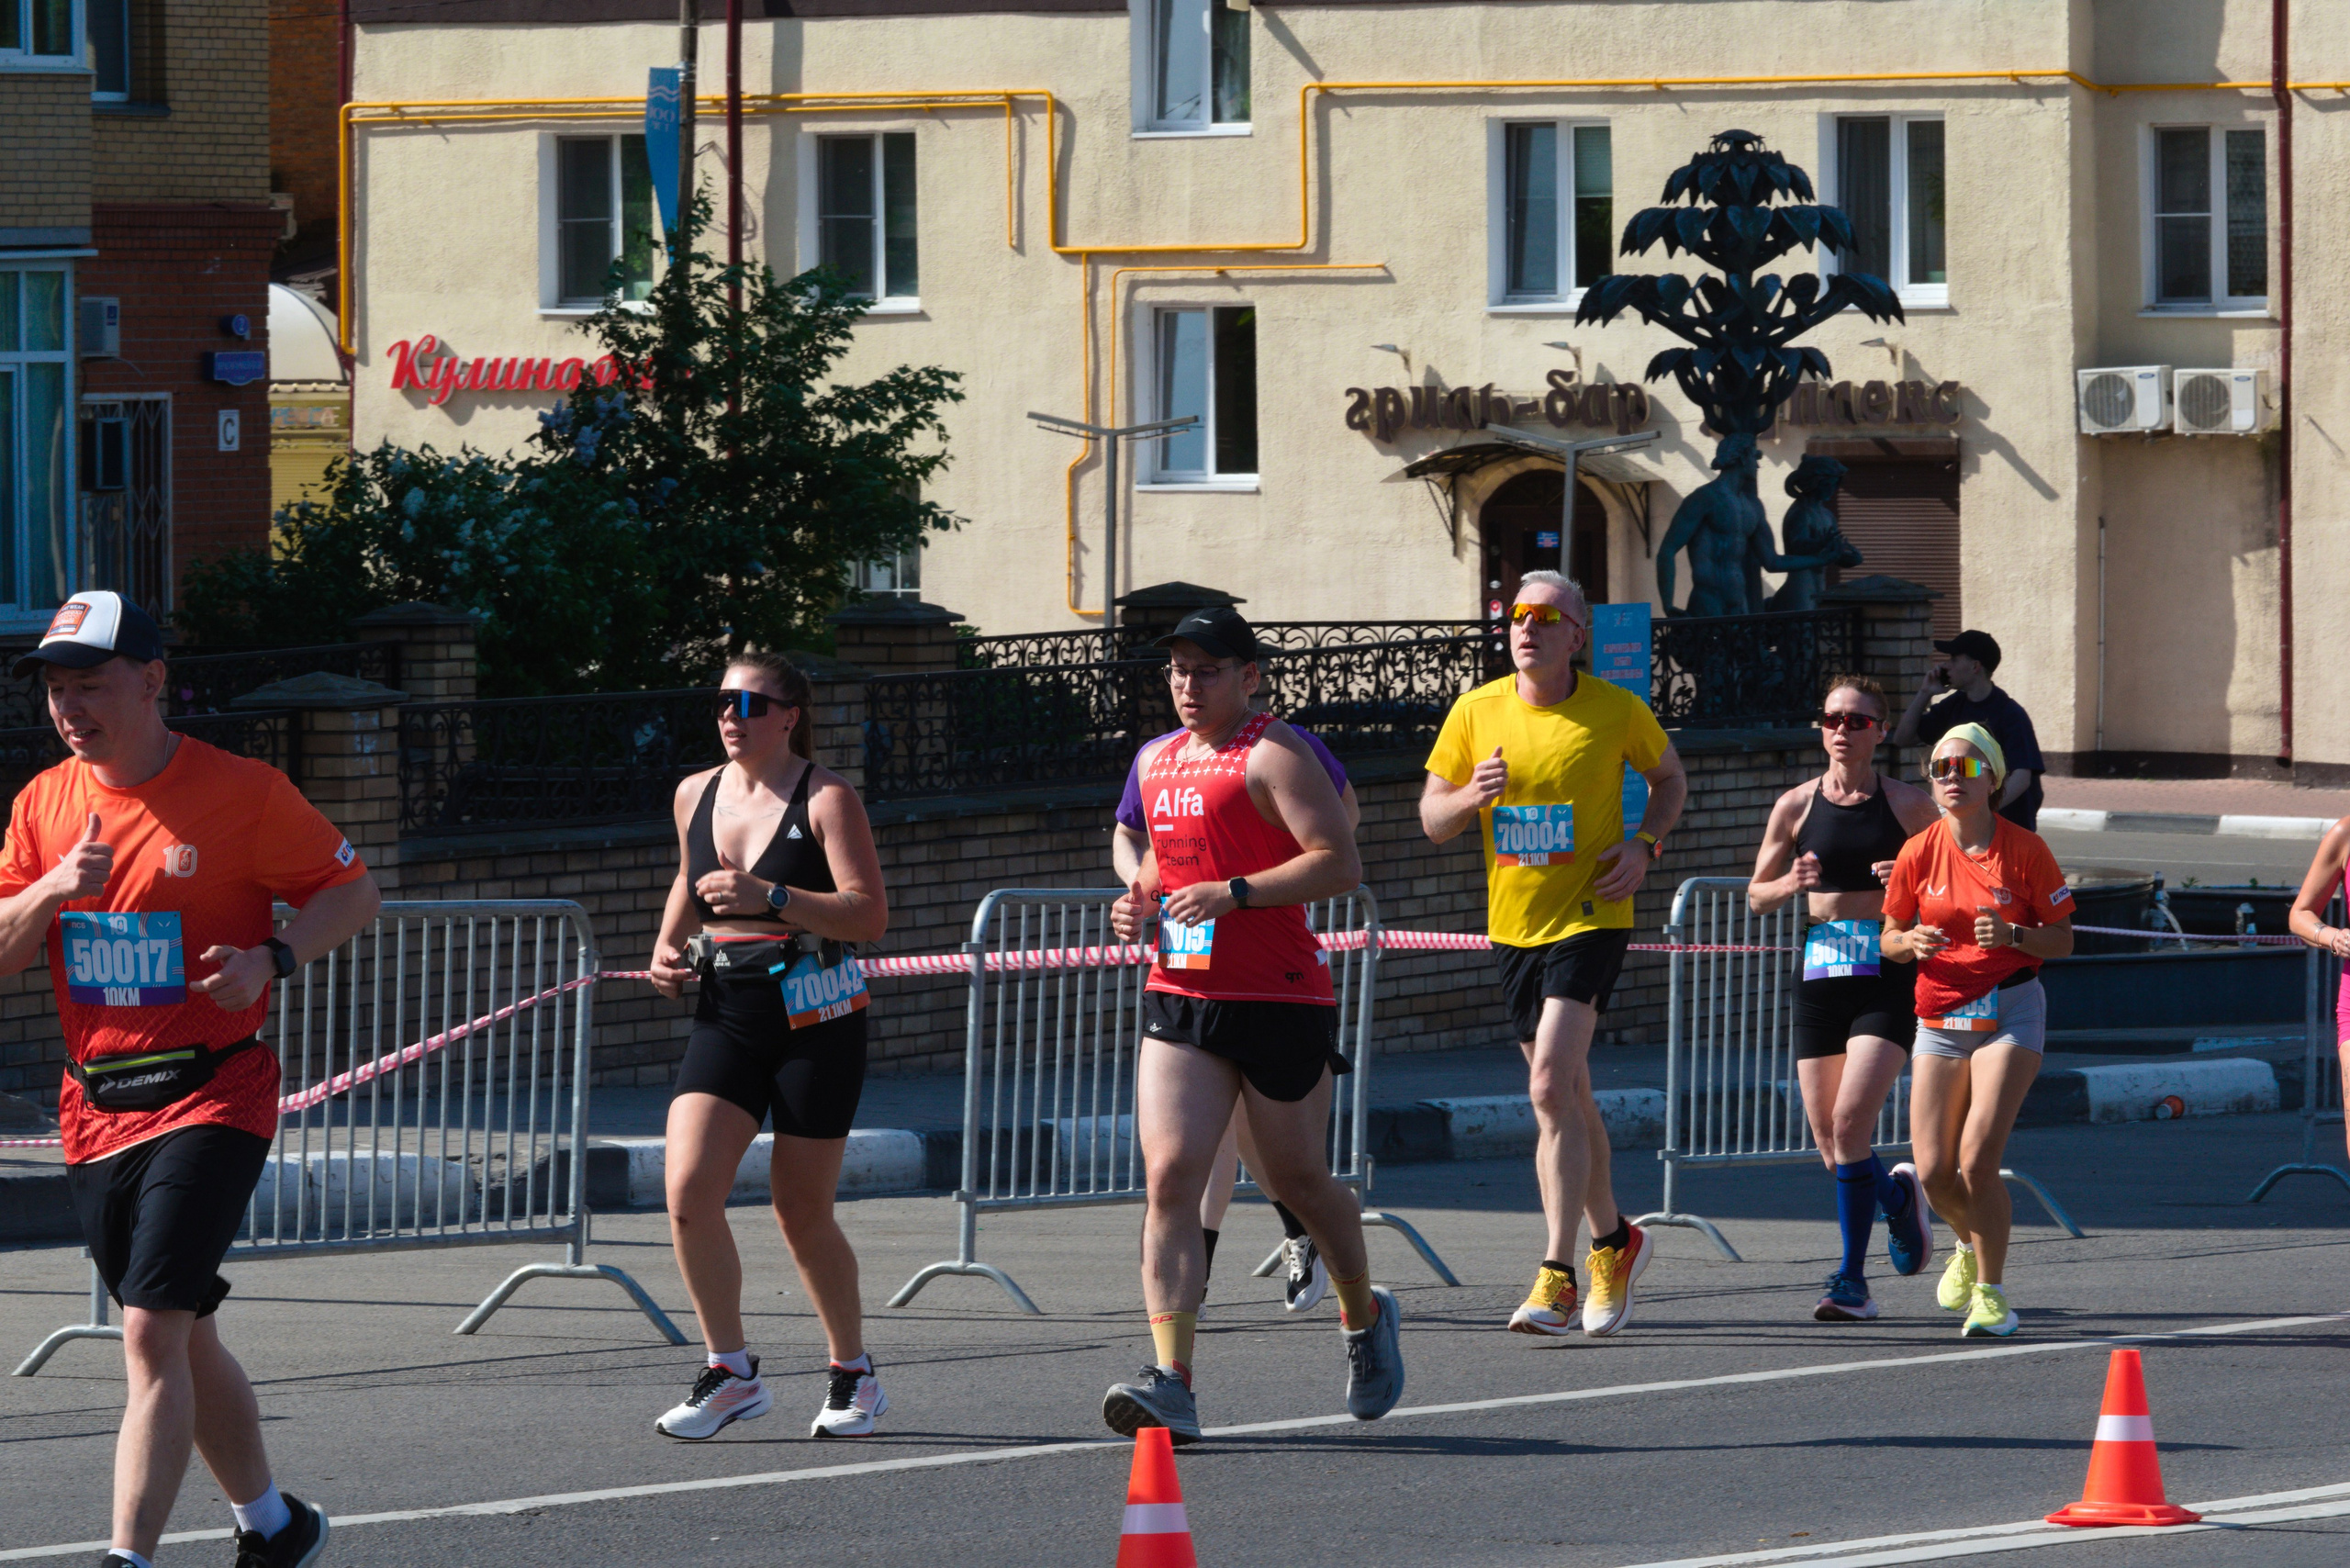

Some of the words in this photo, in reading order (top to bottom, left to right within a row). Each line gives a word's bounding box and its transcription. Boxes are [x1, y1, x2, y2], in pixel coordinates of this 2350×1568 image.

[386, 334, 690, 405] Кулина
[1346, 369, 1649, 443] гриль-бар
[1699, 379, 1962, 440] плекс
[1153, 787, 1204, 817] Alfa
[1158, 834, 1207, 852] running
[1497, 821, 1570, 852] 70004
[1165, 853, 1201, 867] team
[1517, 852, 1550, 868] 21.1KM
[73, 939, 170, 983] 50017
[1811, 935, 1871, 967] 50117
[1827, 964, 1852, 978] 10KM
[103, 987, 140, 1007] 10KM
[787, 958, 864, 1011] 70042
[818, 998, 853, 1023] 21.1KM
[1942, 1016, 1972, 1031] 21.1KM
[117, 1070, 182, 1090] DEMIX
